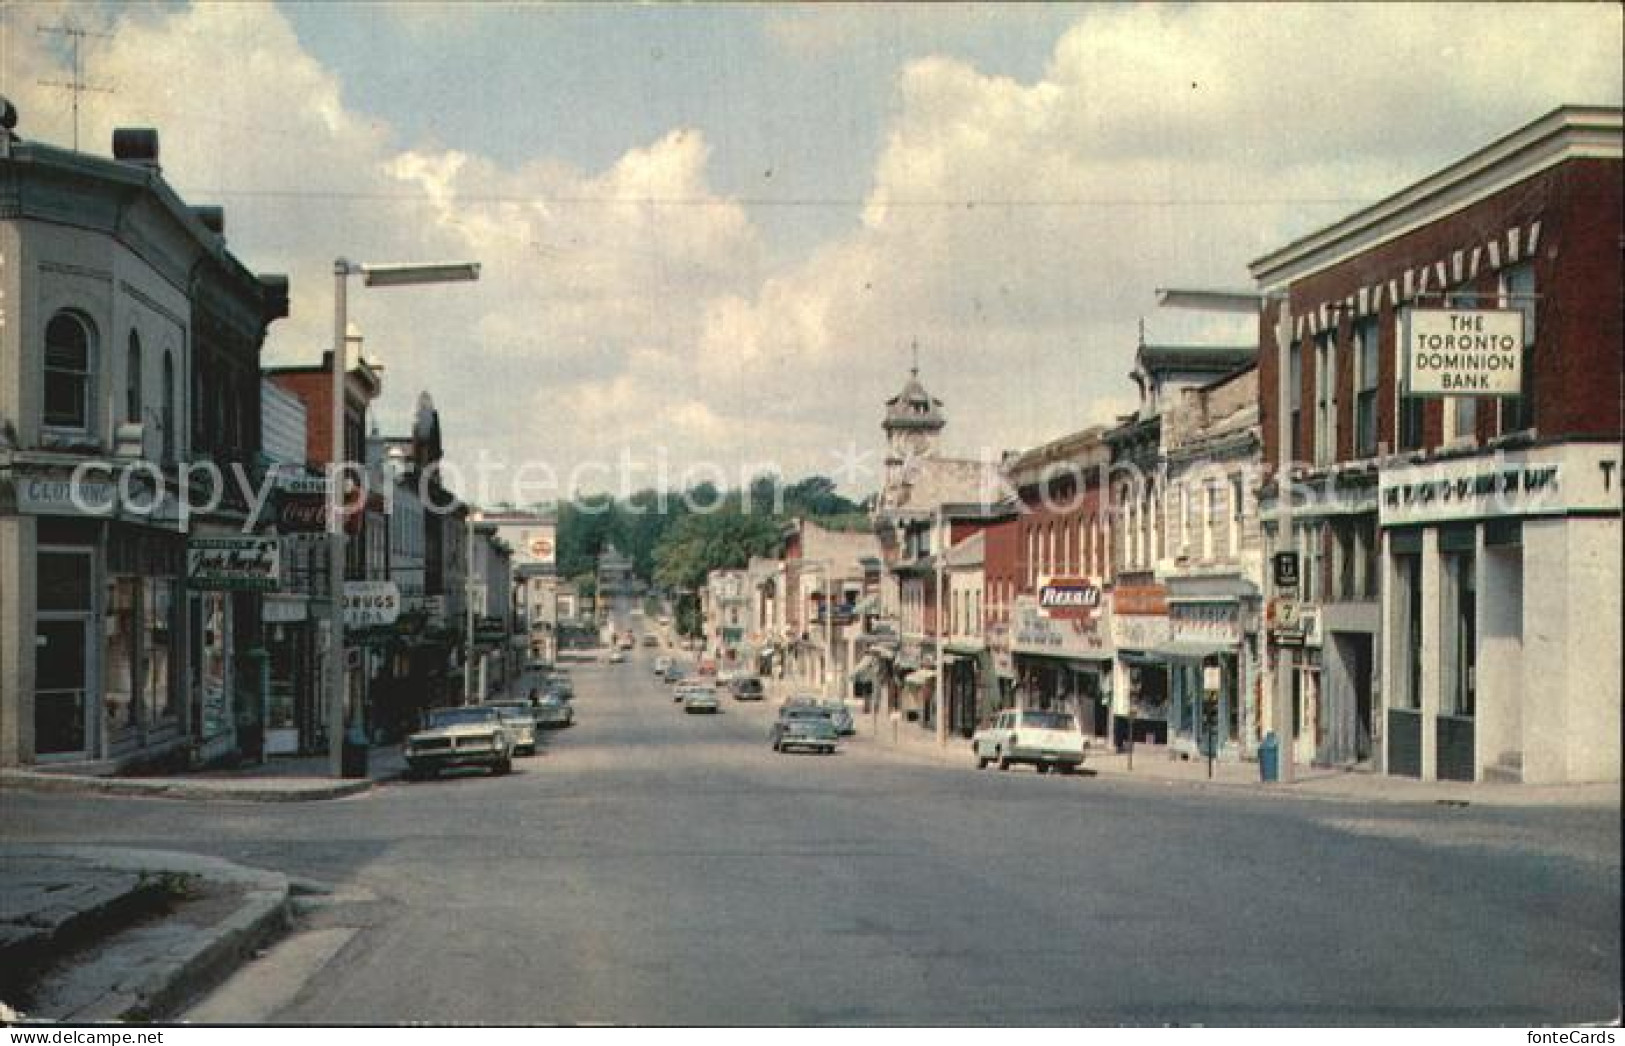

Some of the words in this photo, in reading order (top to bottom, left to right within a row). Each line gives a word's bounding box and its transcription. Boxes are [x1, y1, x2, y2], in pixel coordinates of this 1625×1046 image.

[1450, 315, 1484, 331] THE
[1417, 334, 1514, 350] TORONTO
[1416, 353, 1515, 370] DOMINION
[1441, 373, 1489, 389] BANK
[1283, 604, 1294, 621] 7
